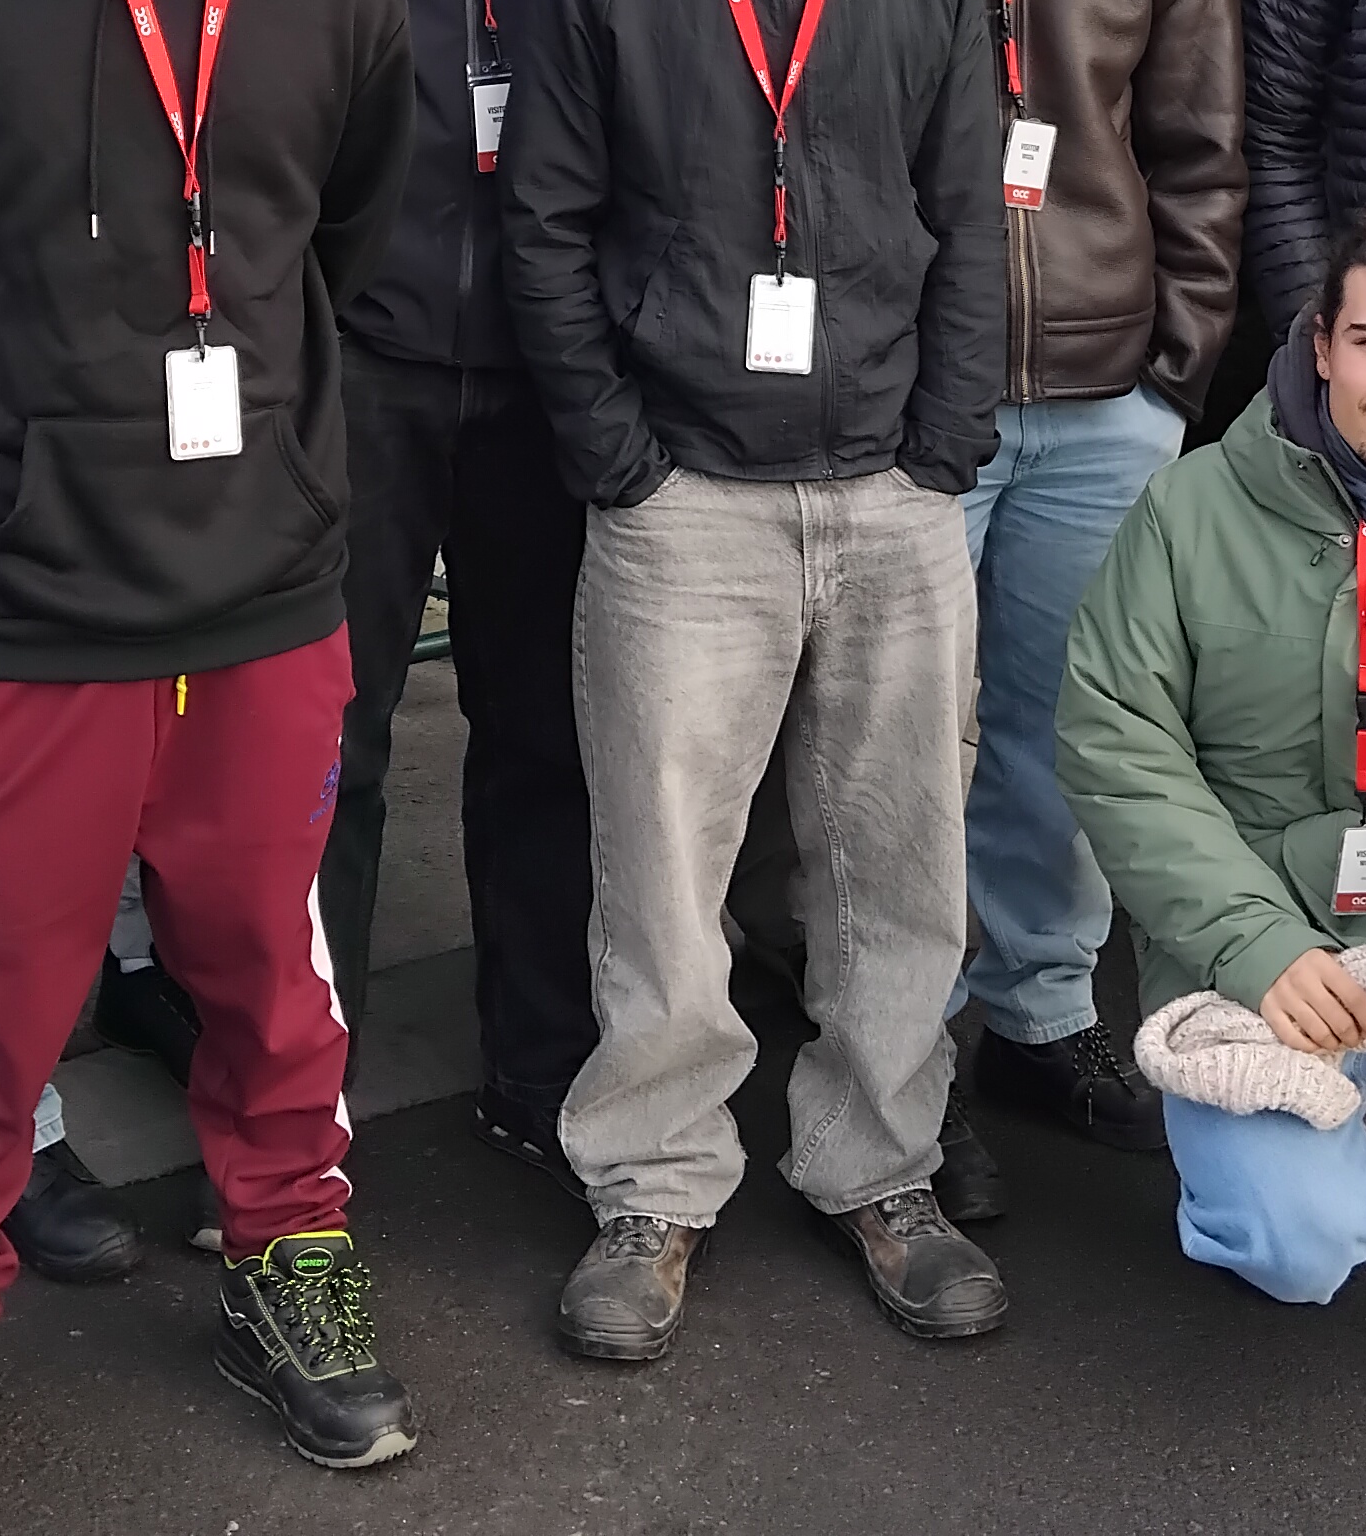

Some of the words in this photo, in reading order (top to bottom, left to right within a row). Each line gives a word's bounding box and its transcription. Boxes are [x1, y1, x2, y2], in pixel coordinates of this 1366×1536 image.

[134, 6, 151, 36] acc
[207, 6, 220, 36] acc
[788, 60, 799, 84] acc
